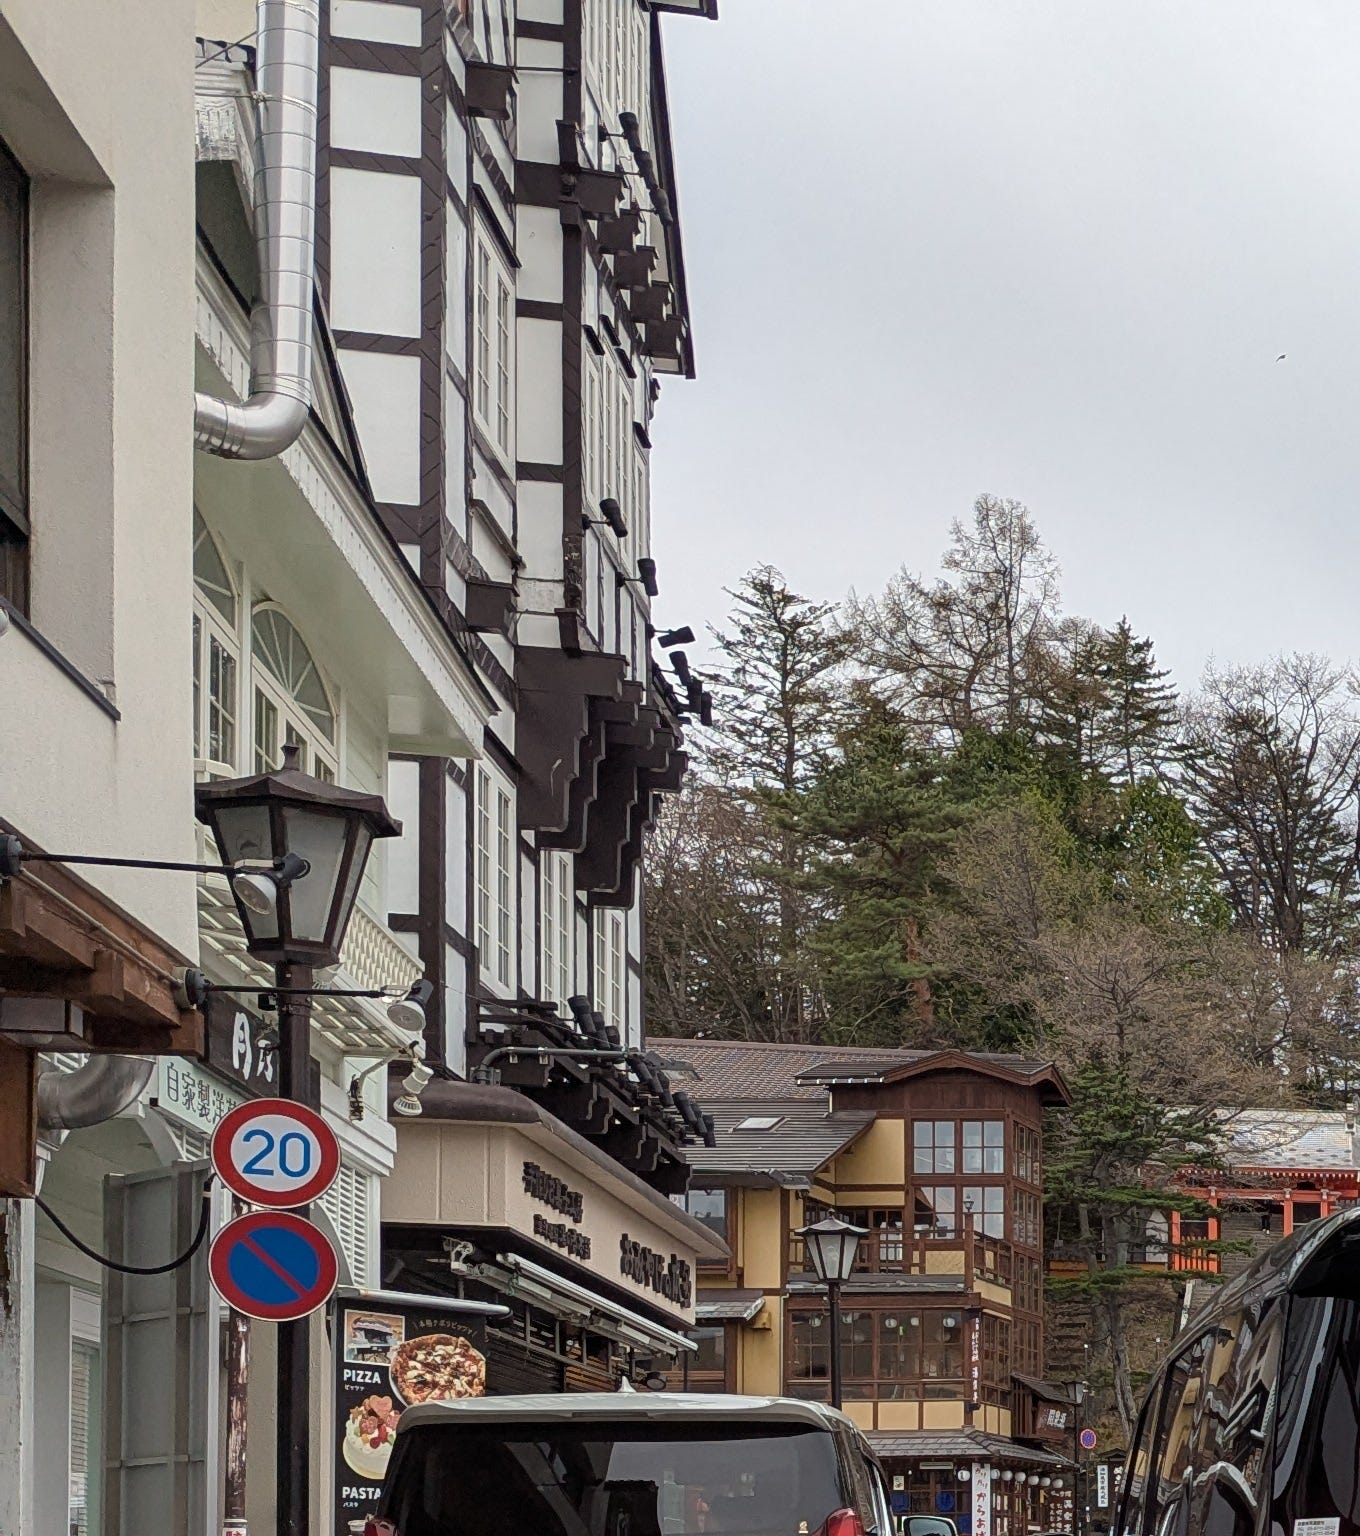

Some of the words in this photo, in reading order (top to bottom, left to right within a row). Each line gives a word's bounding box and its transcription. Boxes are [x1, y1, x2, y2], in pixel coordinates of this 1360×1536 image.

[242, 1129, 311, 1177] 20
[343, 1369, 381, 1384] PIZZA
[342, 1486, 381, 1500] PASTA
